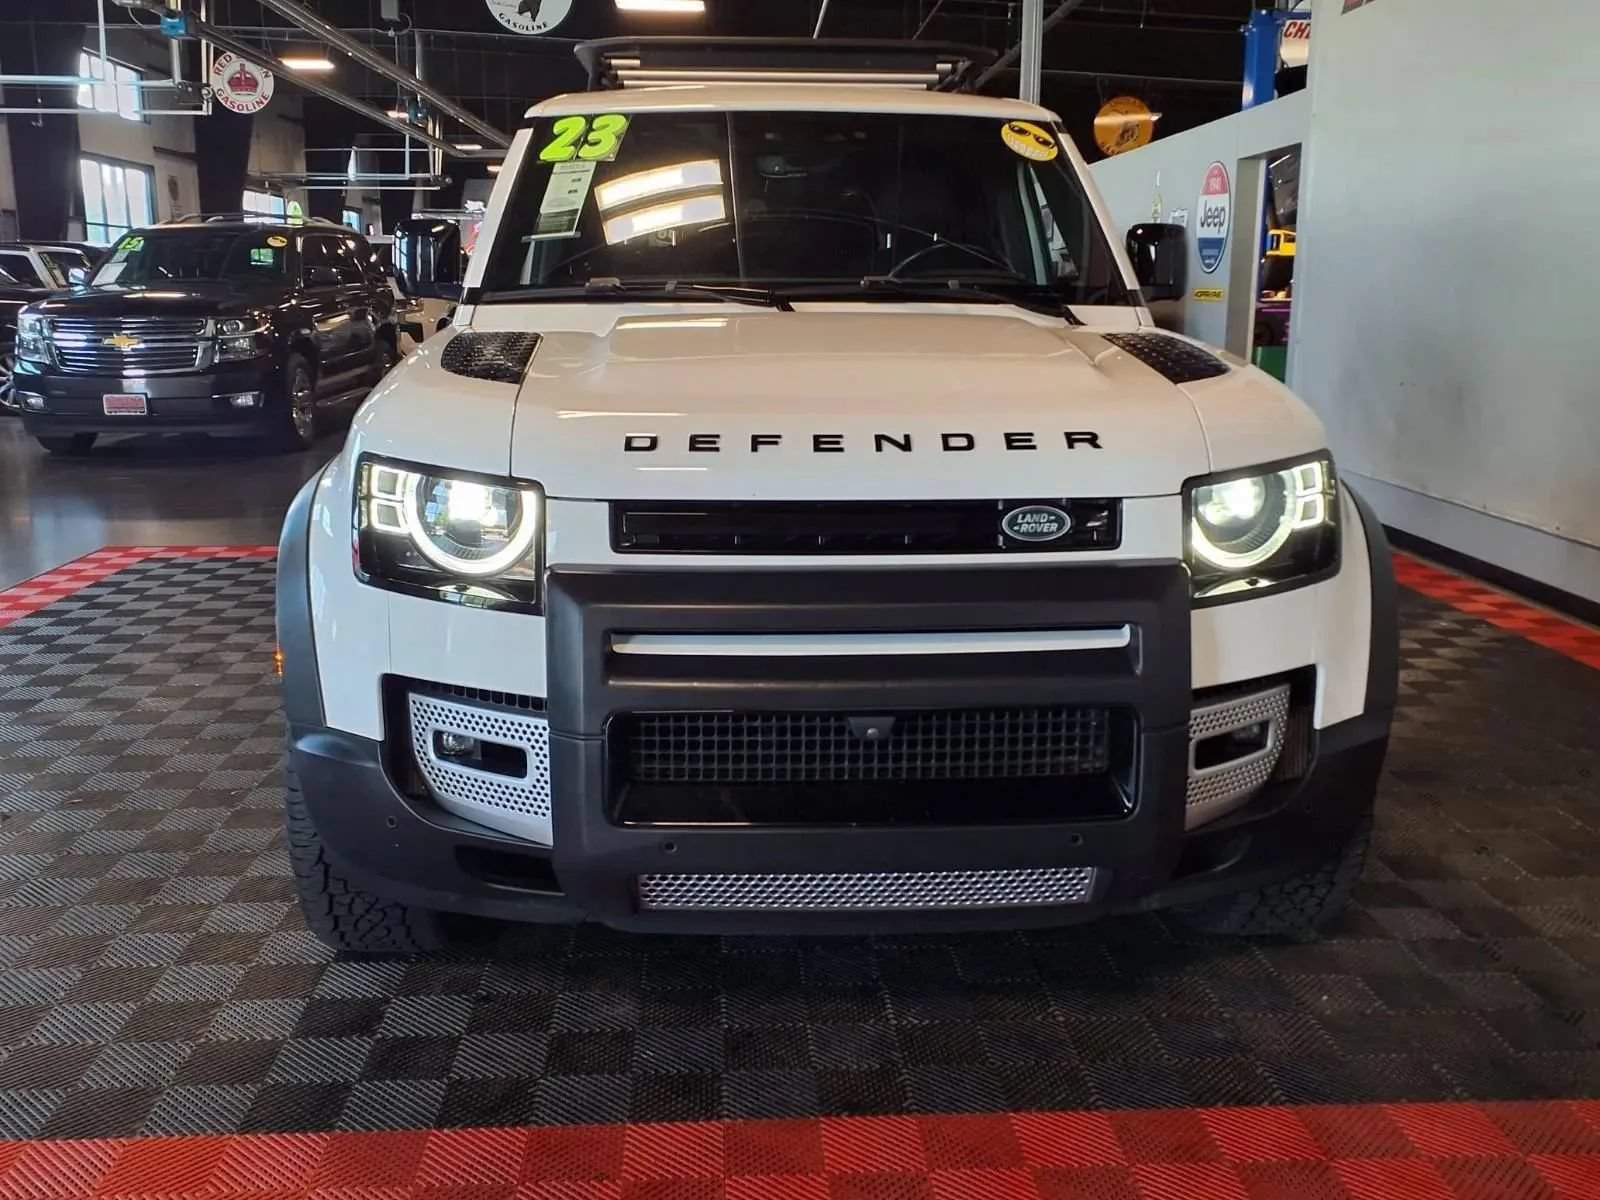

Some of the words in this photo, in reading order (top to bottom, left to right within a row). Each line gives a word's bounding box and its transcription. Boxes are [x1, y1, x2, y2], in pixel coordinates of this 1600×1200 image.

[499, 12, 548, 32] GASOLINE
[213, 54, 233, 76] RED
[216, 88, 270, 112] GASOLINE
[539, 114, 627, 162] 23
[1200, 199, 1226, 235] Jeep
[623, 430, 1104, 453] DEFENDER
